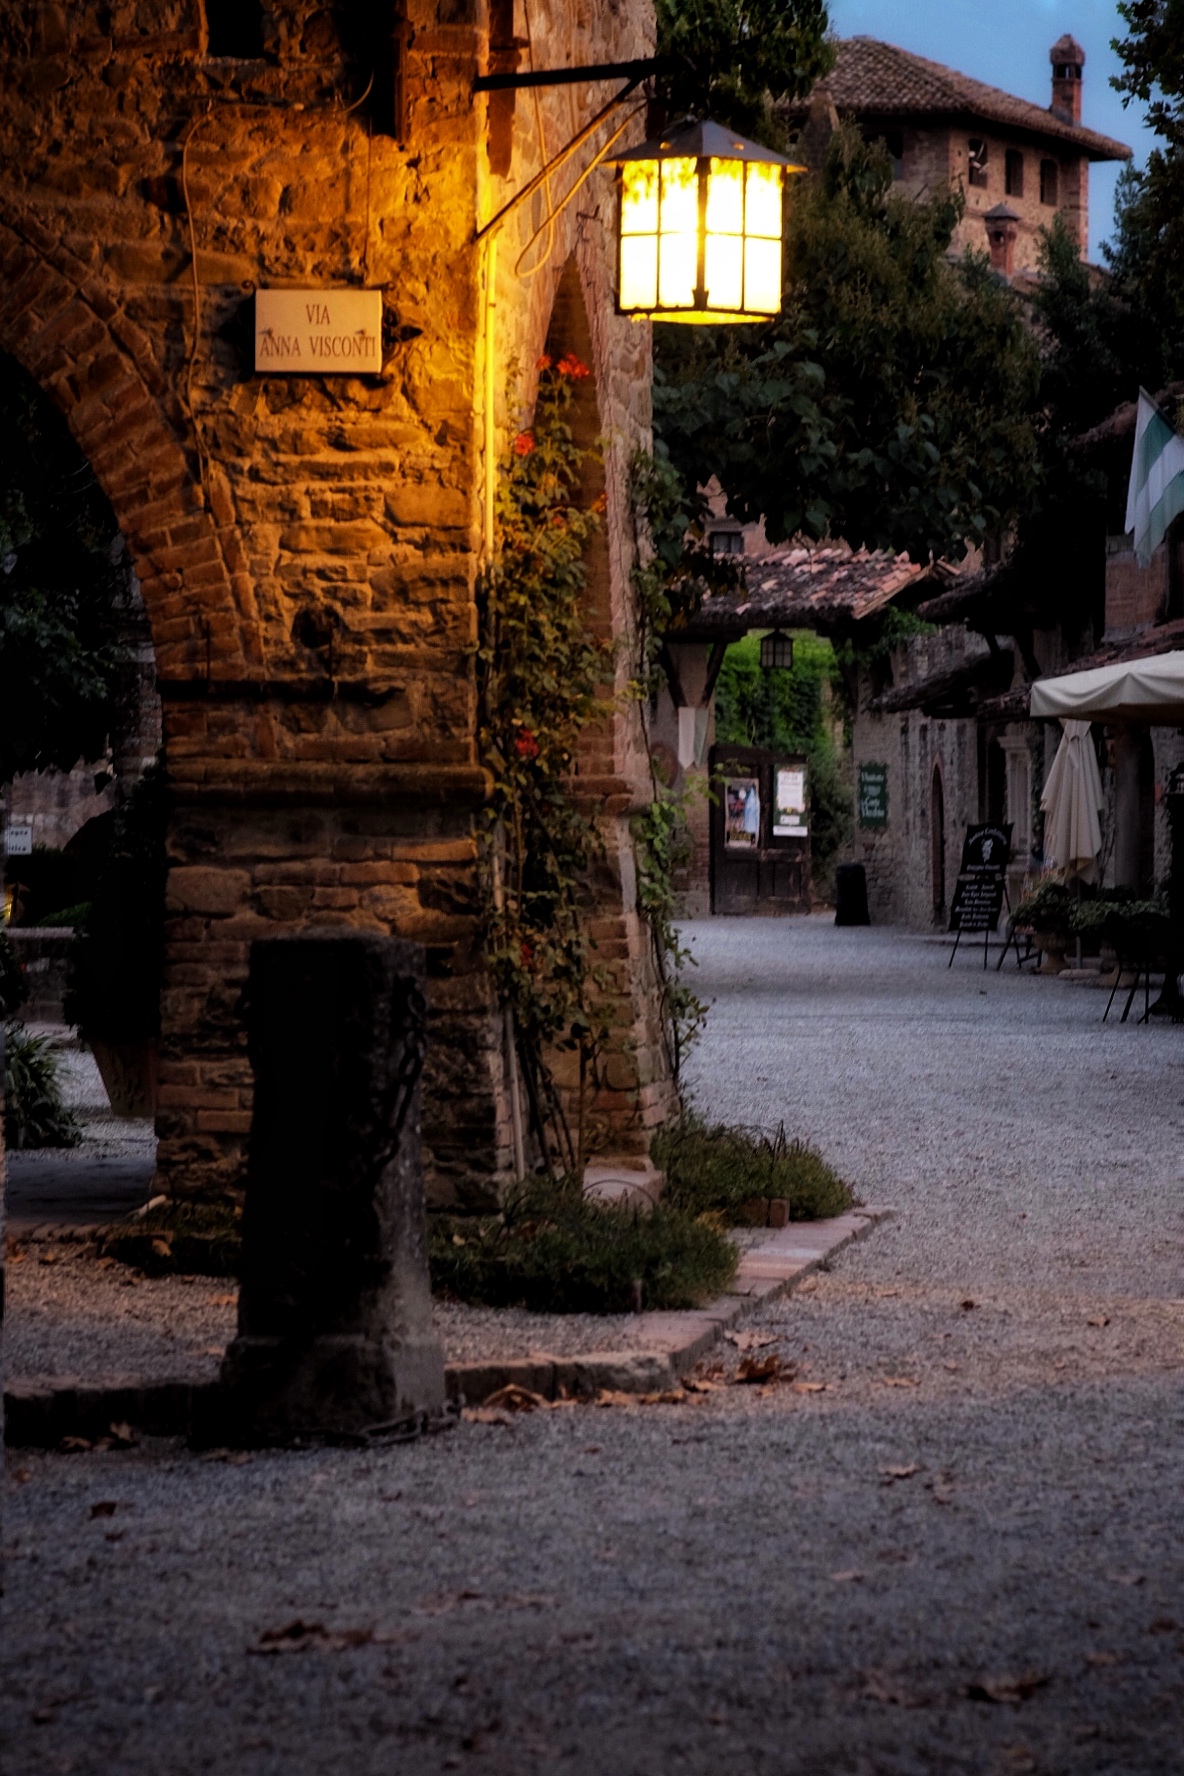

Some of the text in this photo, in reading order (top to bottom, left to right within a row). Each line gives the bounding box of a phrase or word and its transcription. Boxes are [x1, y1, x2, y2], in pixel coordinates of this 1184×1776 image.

[306, 304, 330, 325] VIA
[260, 336, 376, 357] ANNA VISCONTI
